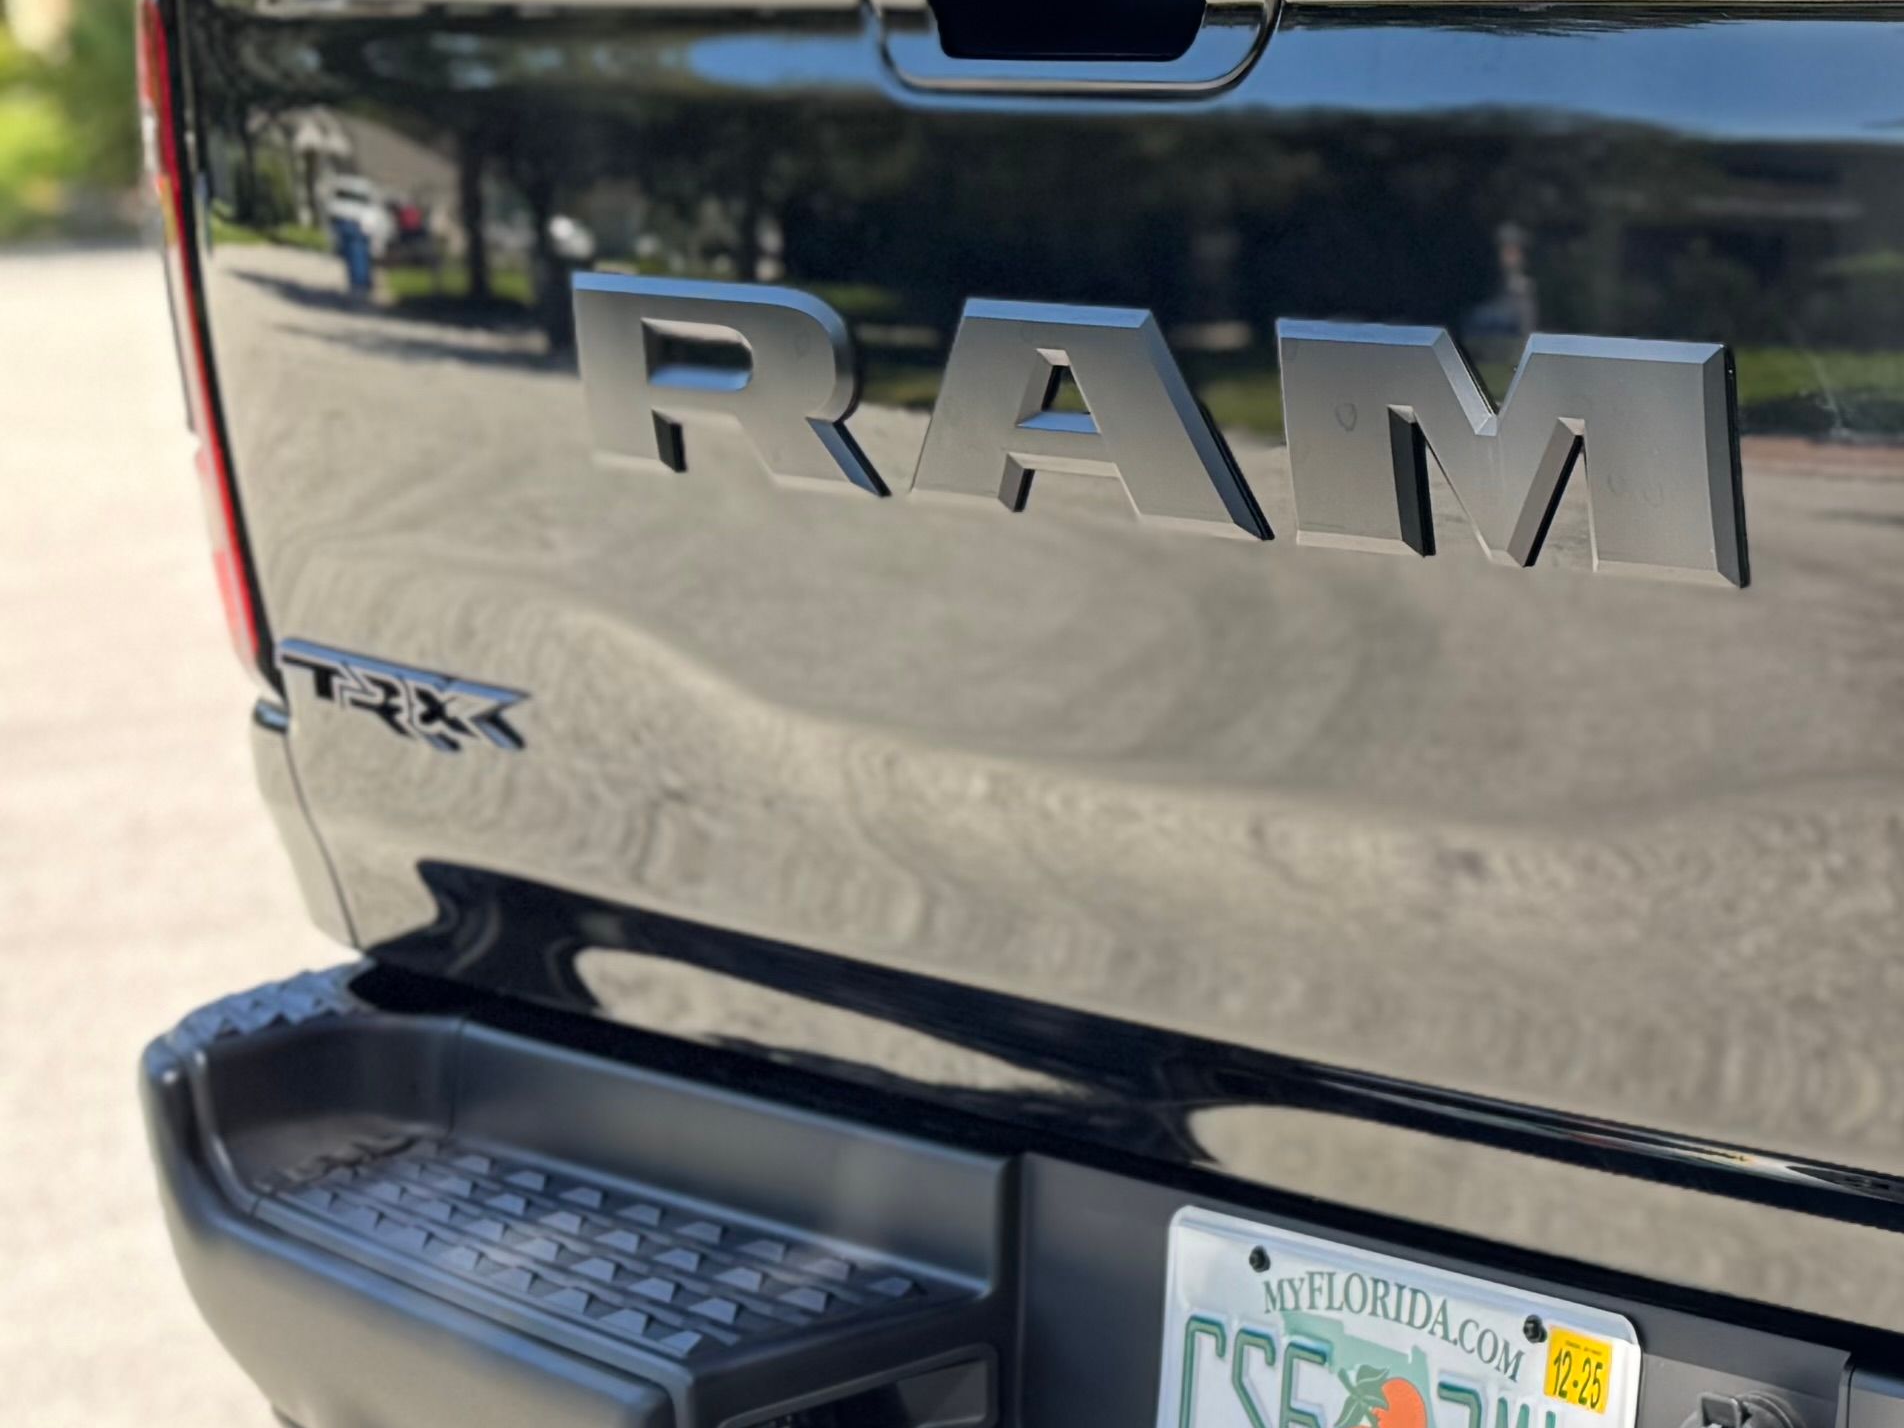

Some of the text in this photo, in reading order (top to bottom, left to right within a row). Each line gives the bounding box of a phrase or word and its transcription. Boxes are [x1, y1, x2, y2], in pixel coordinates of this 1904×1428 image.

[572, 271, 1751, 589] RAM
[279, 638, 531, 752] TRX
[1263, 1271, 1525, 1382] MYFLORIDA.COM
